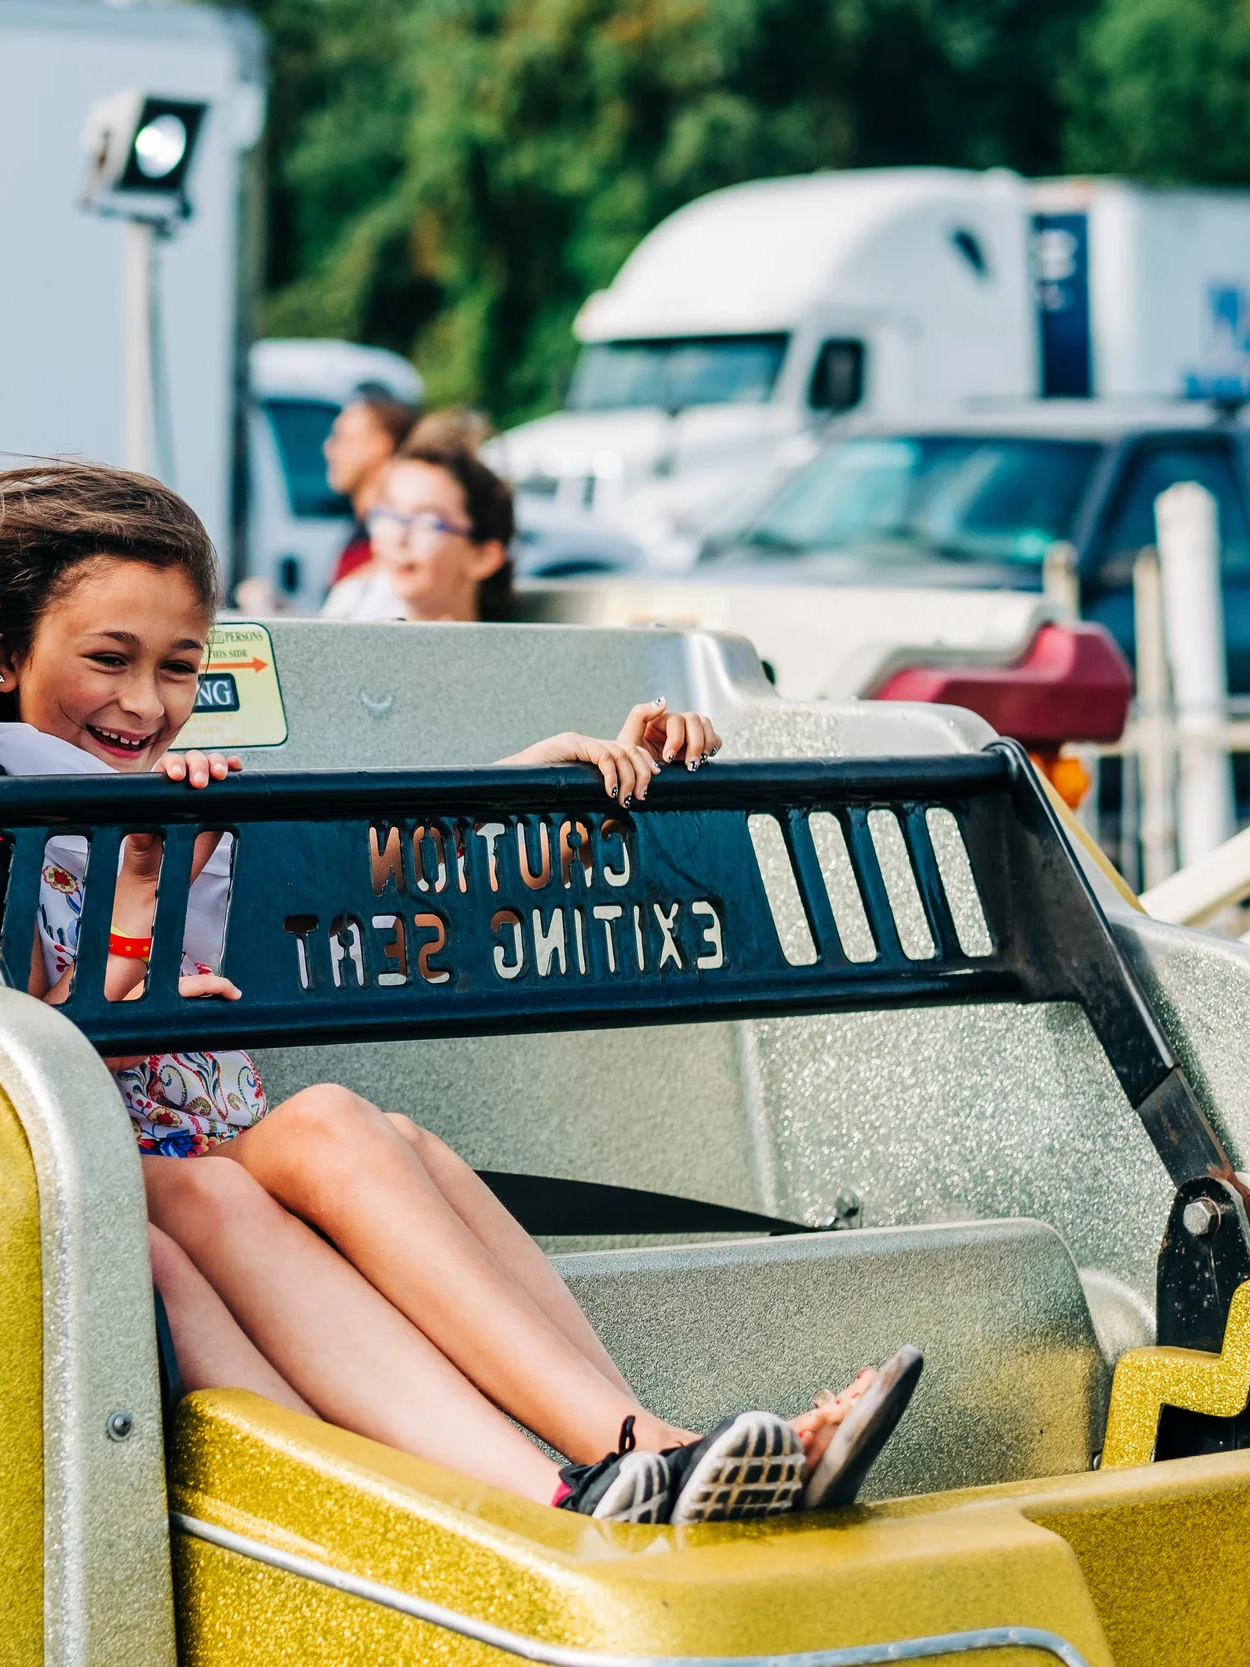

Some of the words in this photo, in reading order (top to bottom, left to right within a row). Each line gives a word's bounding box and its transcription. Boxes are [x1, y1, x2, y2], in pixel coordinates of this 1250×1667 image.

[225, 632, 263, 643] PERSONS
[209, 650, 227, 658] HIS
[229, 649, 247, 658] SIDE
[196, 680, 232, 706] NG
